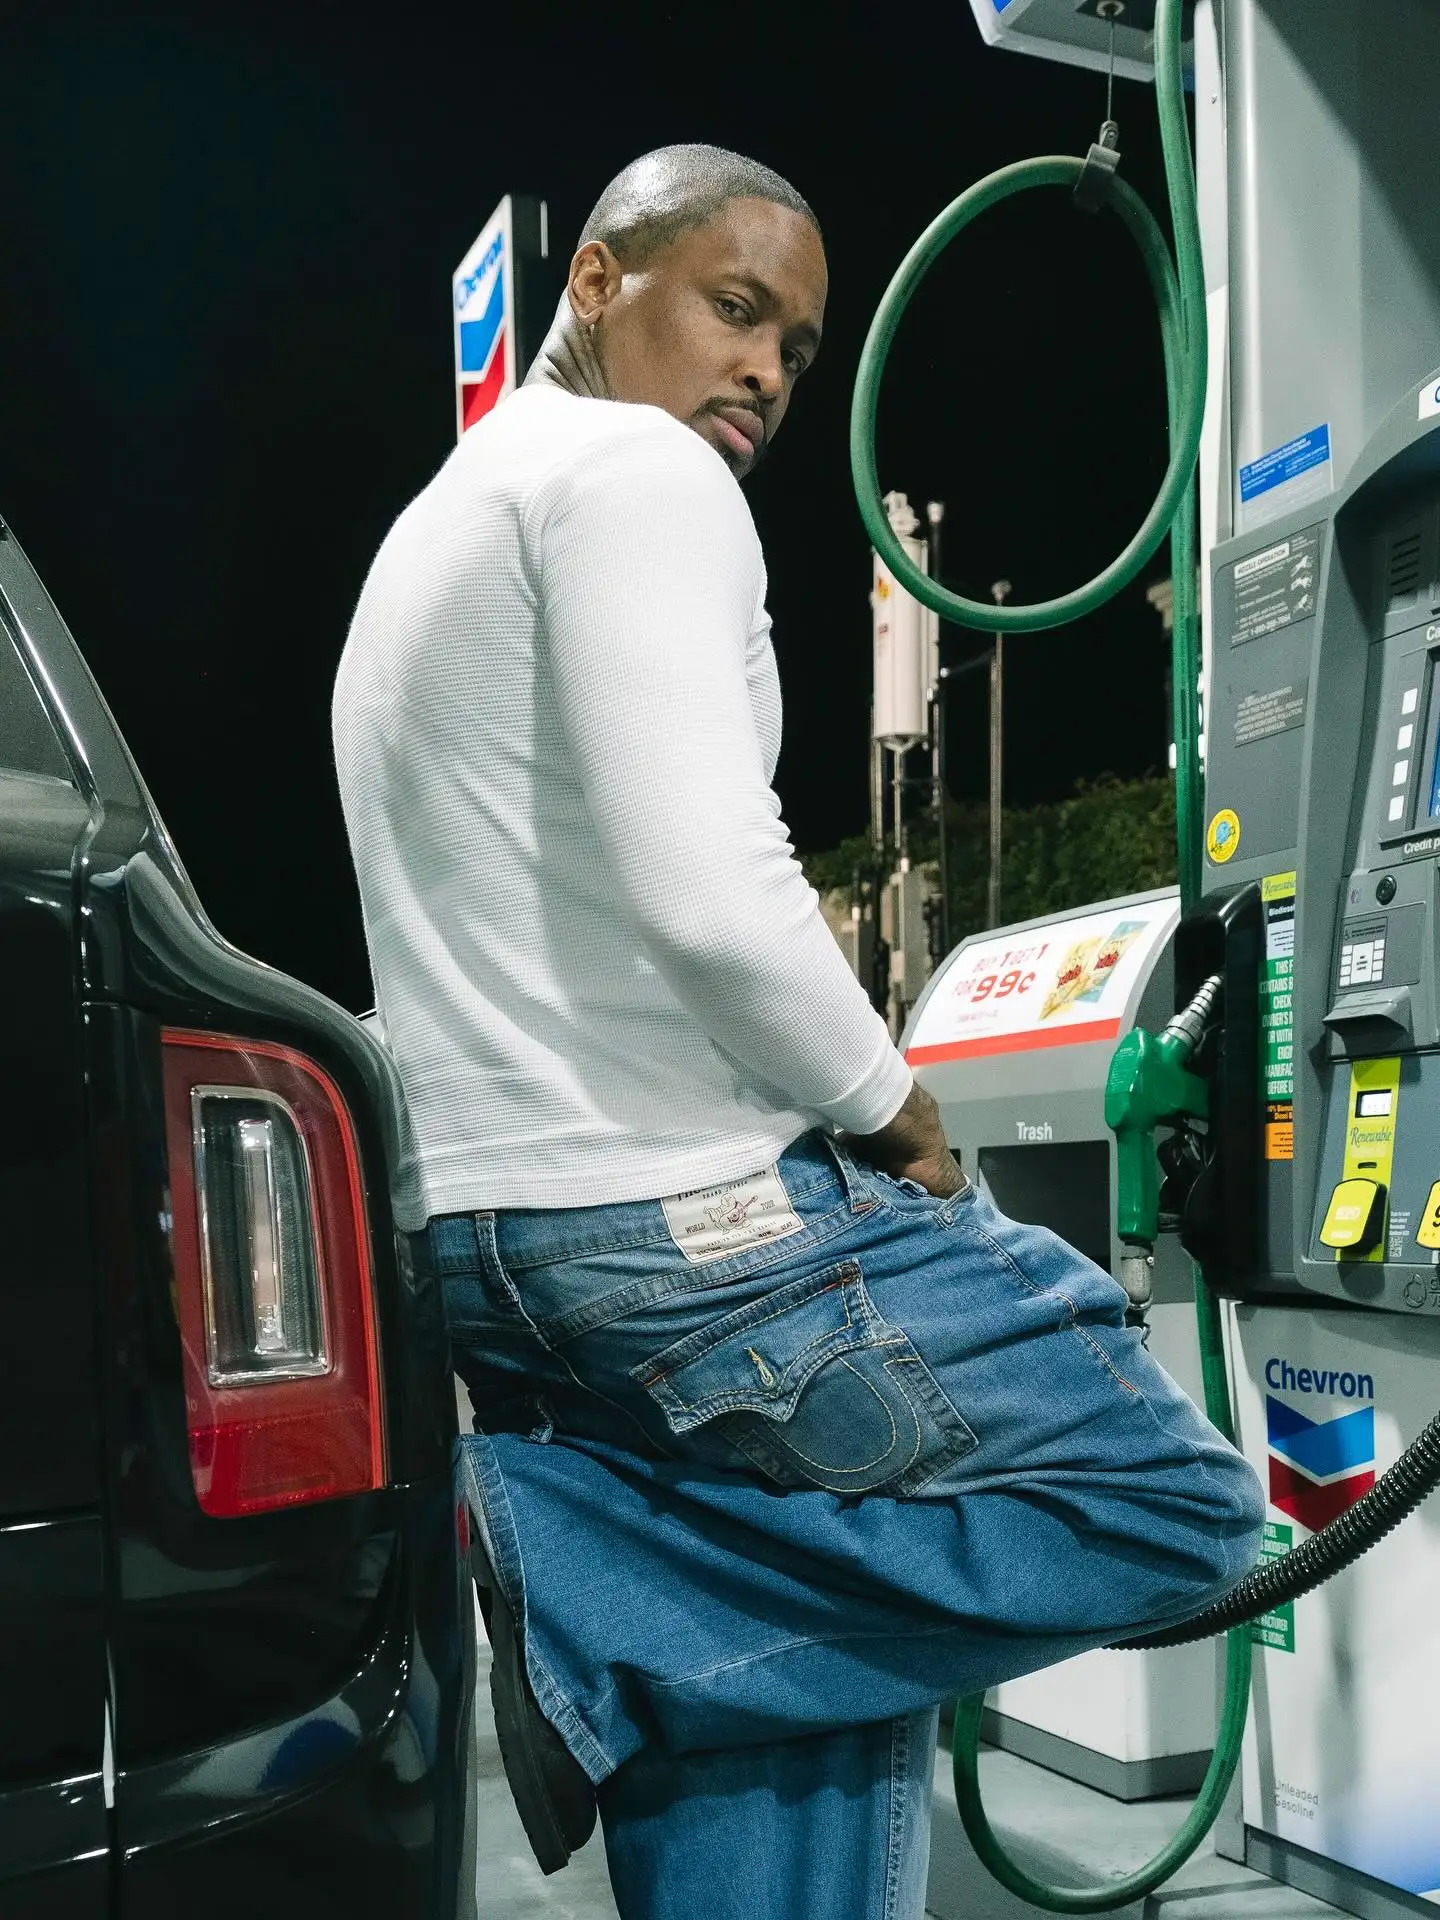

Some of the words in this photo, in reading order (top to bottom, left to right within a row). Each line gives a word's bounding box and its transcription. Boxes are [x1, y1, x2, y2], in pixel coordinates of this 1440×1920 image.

[1016, 1121, 1053, 1141] Trash
[1350, 1126, 1392, 1148] Renewable
[1265, 1358, 1374, 1399] Chevron
